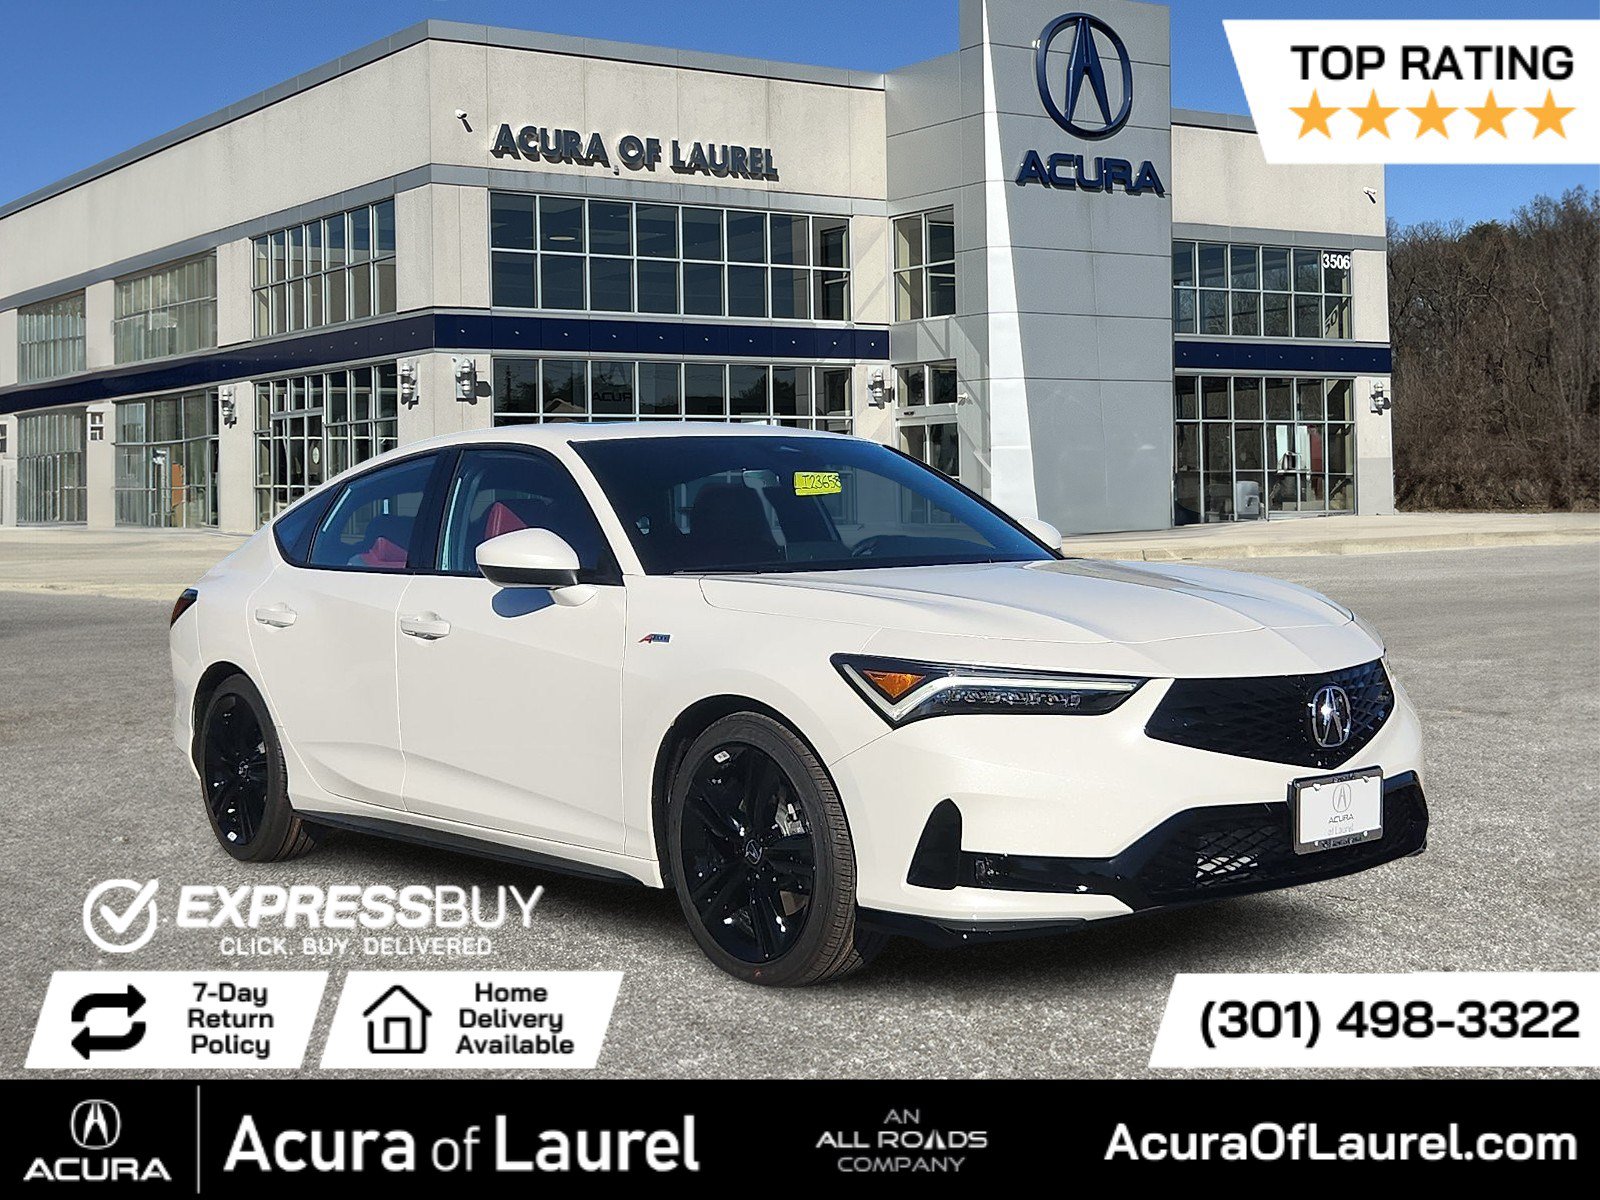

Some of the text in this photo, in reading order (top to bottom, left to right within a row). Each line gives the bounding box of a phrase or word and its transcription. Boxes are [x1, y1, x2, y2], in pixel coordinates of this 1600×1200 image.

[491, 123, 779, 181] ACURA OF LAUREL
[1015, 149, 1166, 198] ACURA
[1322, 253, 1351, 270] 3506
[1328, 813, 1355, 824] ACURA
